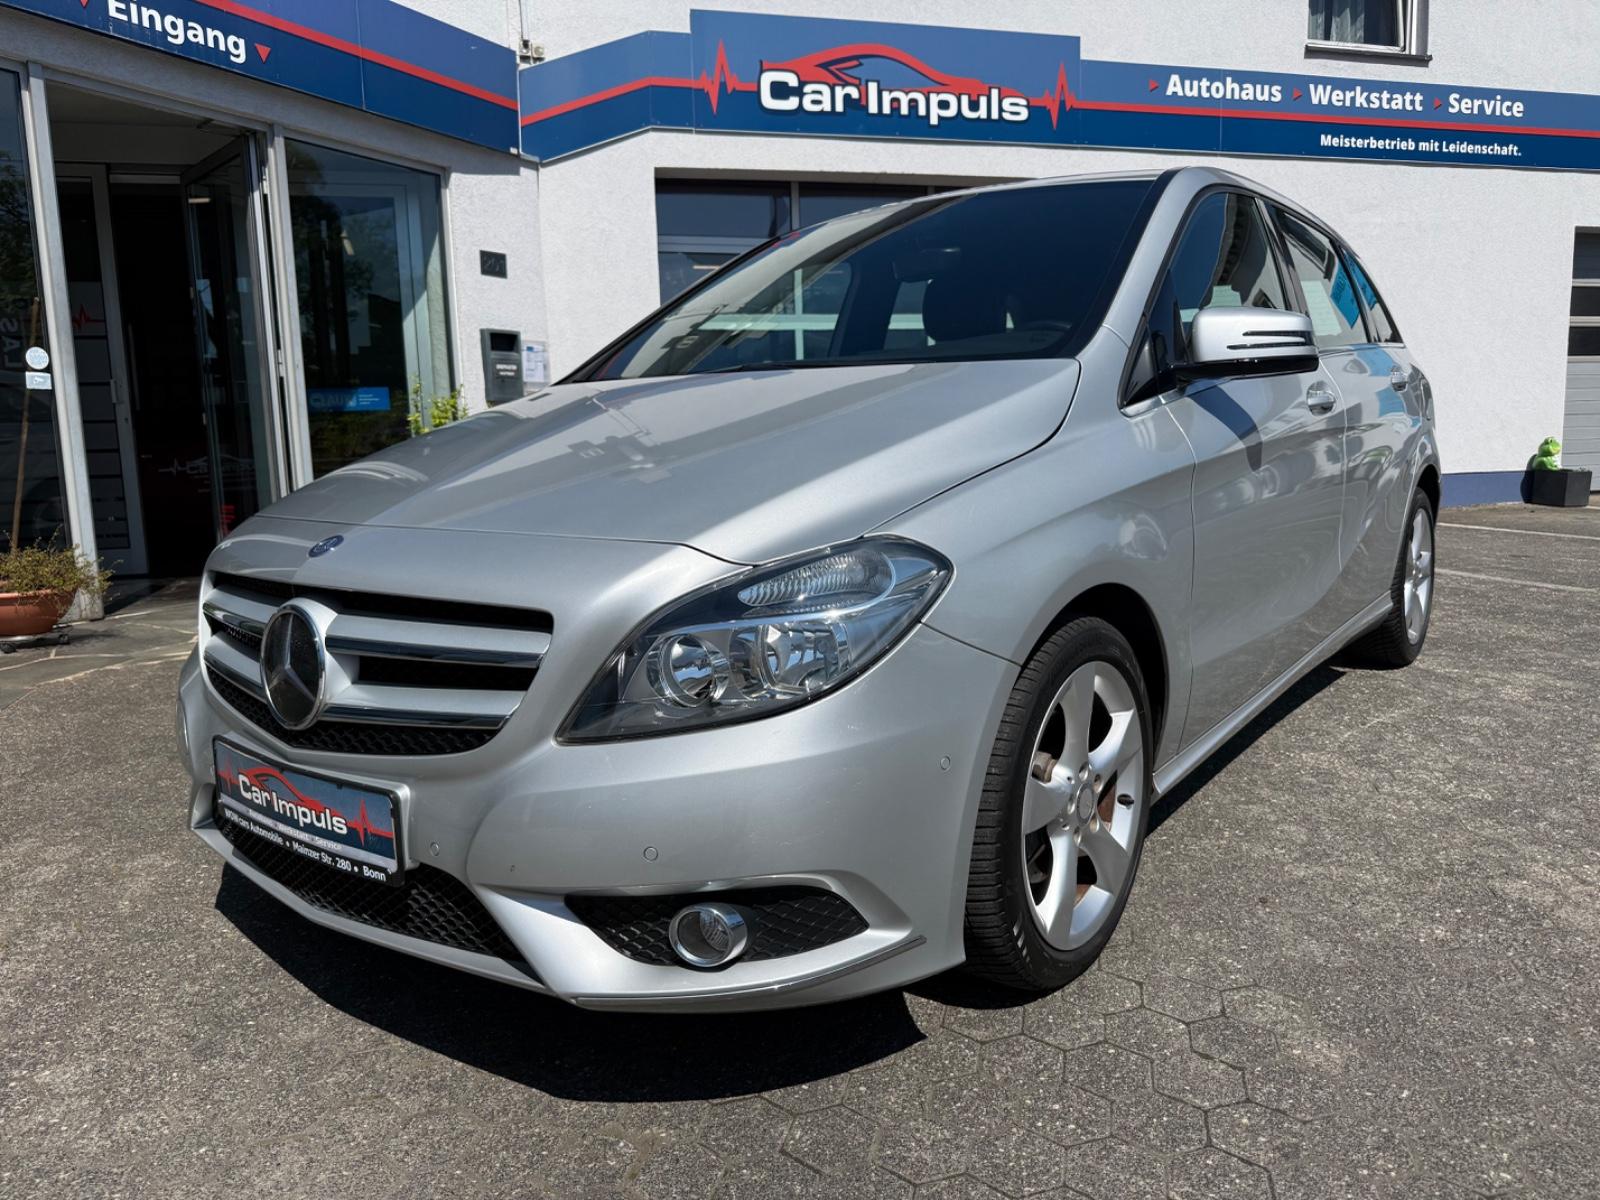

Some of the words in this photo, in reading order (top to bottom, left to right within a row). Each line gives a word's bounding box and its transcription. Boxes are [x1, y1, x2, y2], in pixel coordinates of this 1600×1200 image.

[107, 0, 247, 65] Eingang
[1165, 73, 1283, 103] Autohaus
[1309, 83, 1424, 112] Werkstatt
[1447, 92, 1525, 118] Service
[1320, 133, 1416, 152] Meisterbetrieb
[1418, 137, 1440, 153] mit
[1442, 140, 1523, 157] Leidenschaft.
[335, 857, 352, 872] 280
[362, 865, 388, 883] Bonn
